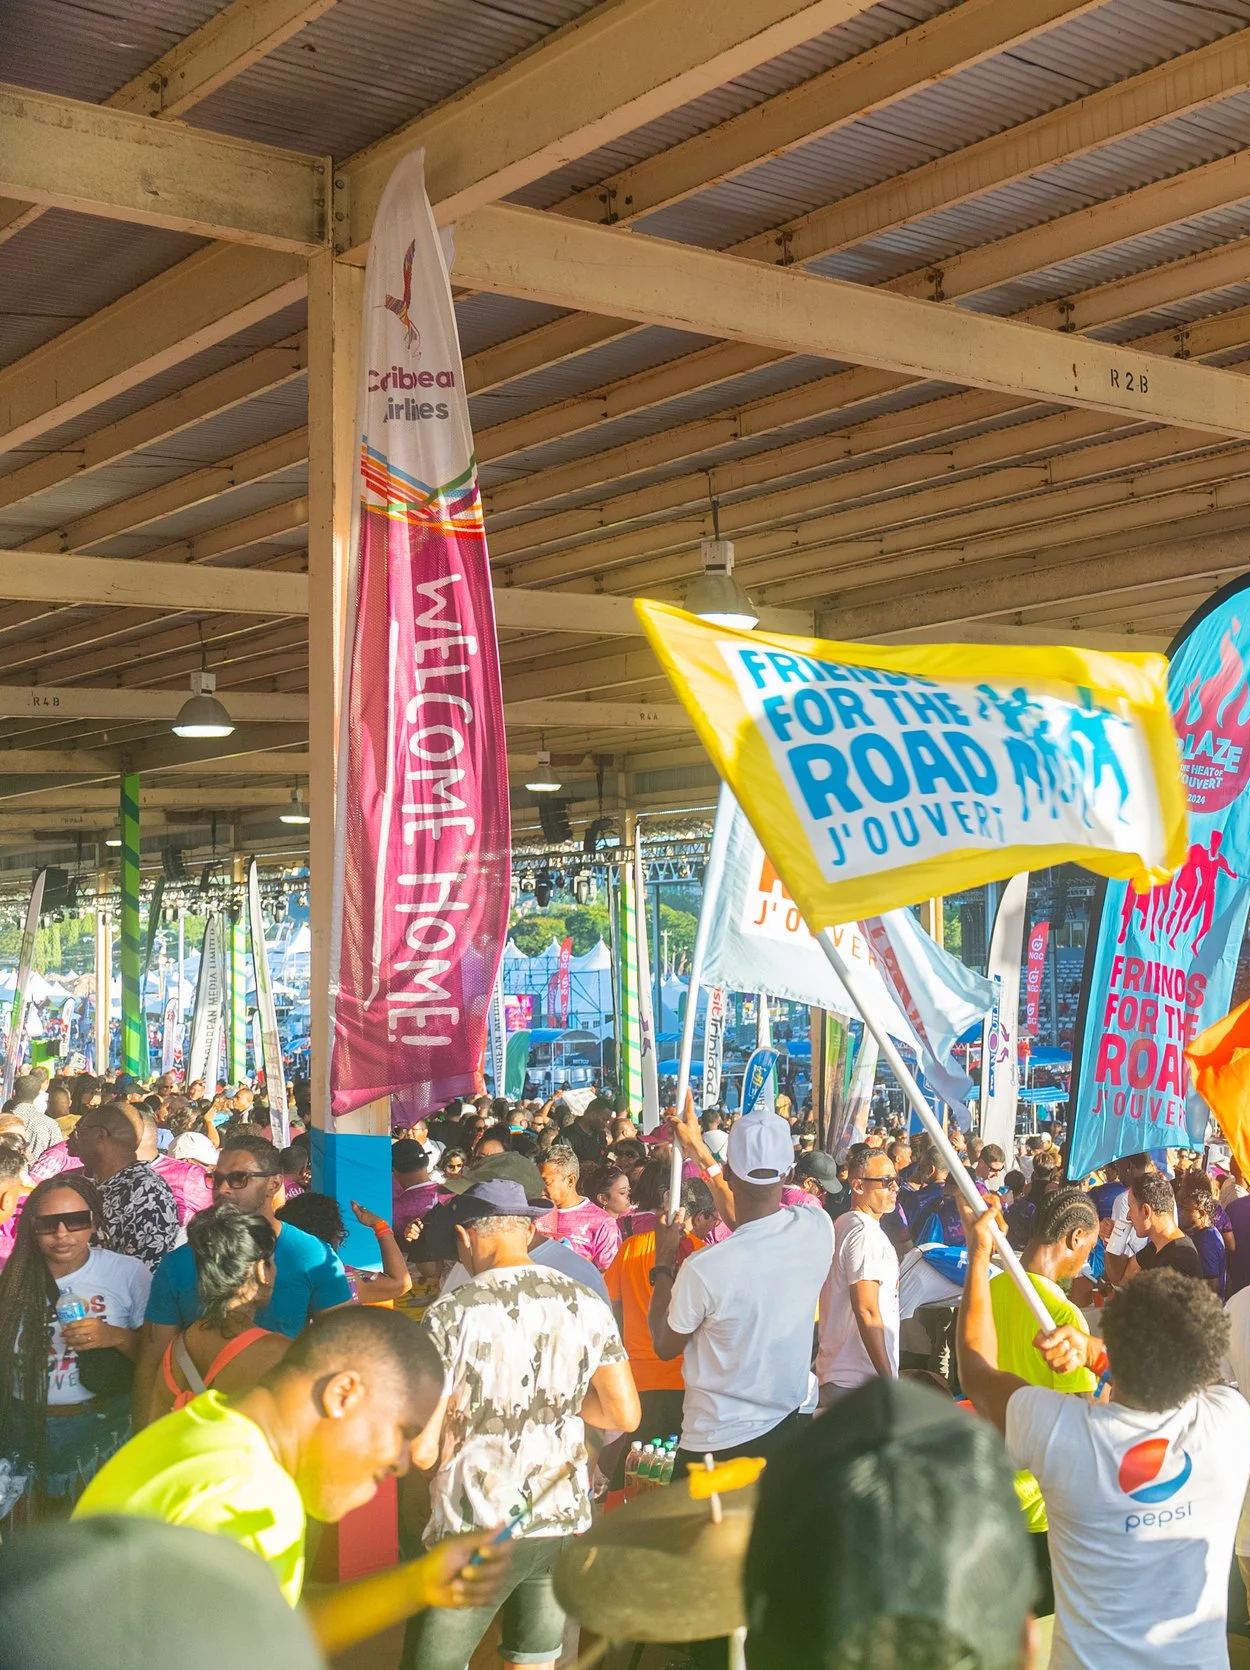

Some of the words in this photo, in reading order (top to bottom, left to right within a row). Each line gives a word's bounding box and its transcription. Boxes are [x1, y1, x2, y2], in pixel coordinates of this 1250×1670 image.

[368, 365, 455, 392] Caribea
[383, 397, 449, 423] irlies
[739, 650, 940, 690] FRIEN
[401, 572, 478, 848] WELCOME
[763, 687, 876, 742] FOR
[869, 689, 971, 726] THE
[787, 730, 999, 820] ROAD
[1179, 773, 1223, 789] OUVERT
[1191, 765, 1215, 776] HEAT
[1188, 794, 1206, 805] 2024
[828, 801, 1005, 866] J'OUVERT
[387, 871, 470, 1048] HOME!
[1029, 951, 1044, 960] NGC
[208, 971, 219, 1006] MEDIA
[1110, 955, 1207, 1009] FRIENDS
[1027, 1017, 1037, 1025] GC
[1103, 993, 1158, 1035] FOR
[1164, 1004, 1199, 1046] THE
[706, 985, 724, 1096] isitTrinidad
[1095, 1032, 1188, 1100] ROA
[1092, 1088, 1187, 1131] J'OUVER
[1125, 1501, 1192, 1533] pepsi
